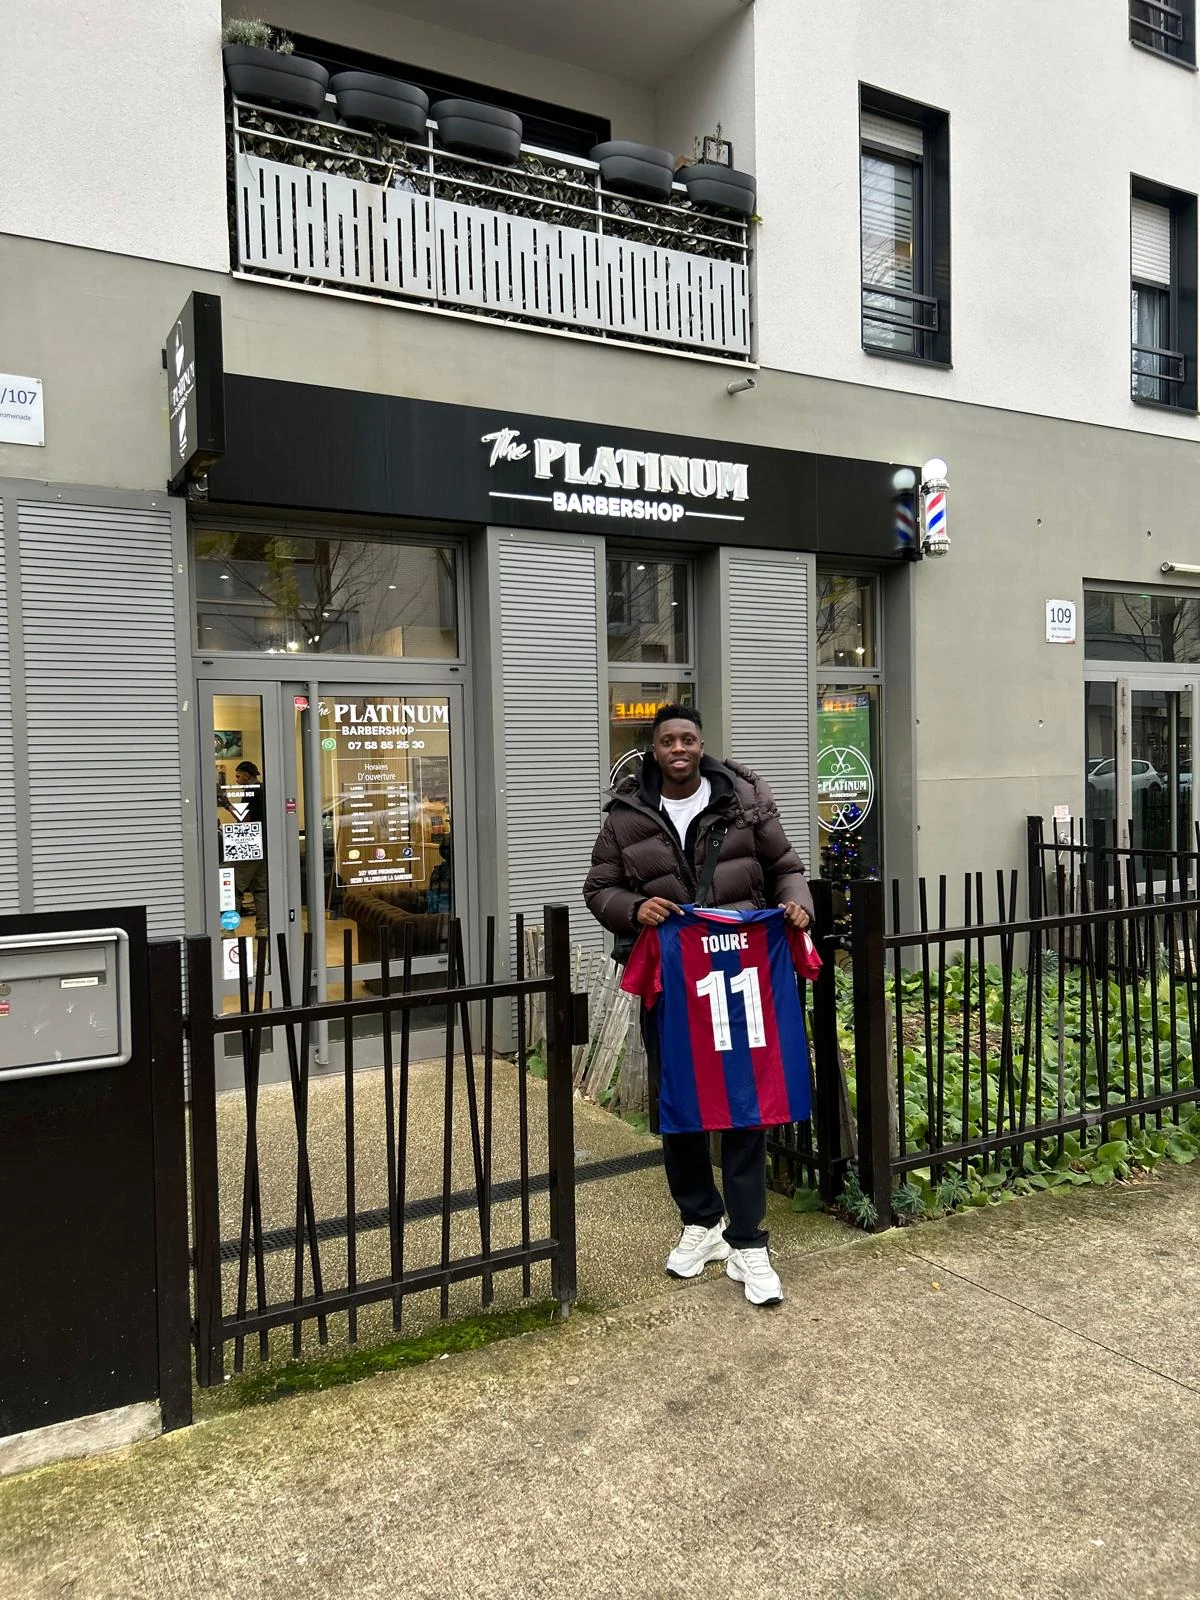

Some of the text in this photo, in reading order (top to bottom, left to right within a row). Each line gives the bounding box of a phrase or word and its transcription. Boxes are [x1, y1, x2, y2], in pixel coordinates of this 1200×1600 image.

[481, 428, 750, 501] The PLATINUM
[553, 492, 685, 522] BARBERSHOP
[1050, 607, 1072, 624] 109
[334, 704, 449, 723] PLATINUM
[341, 725, 415, 736] BARBERSHOP
[348, 741, 362, 750] 07
[364, 741, 378, 750] 58
[380, 740, 394, 750] 85
[411, 740, 425, 749] 30
[364, 763, 389, 771] Horaires
[823, 780, 867, 791] PLATINUM
[700, 933, 749, 953] TOURE
[695, 966, 767, 1051] 11
